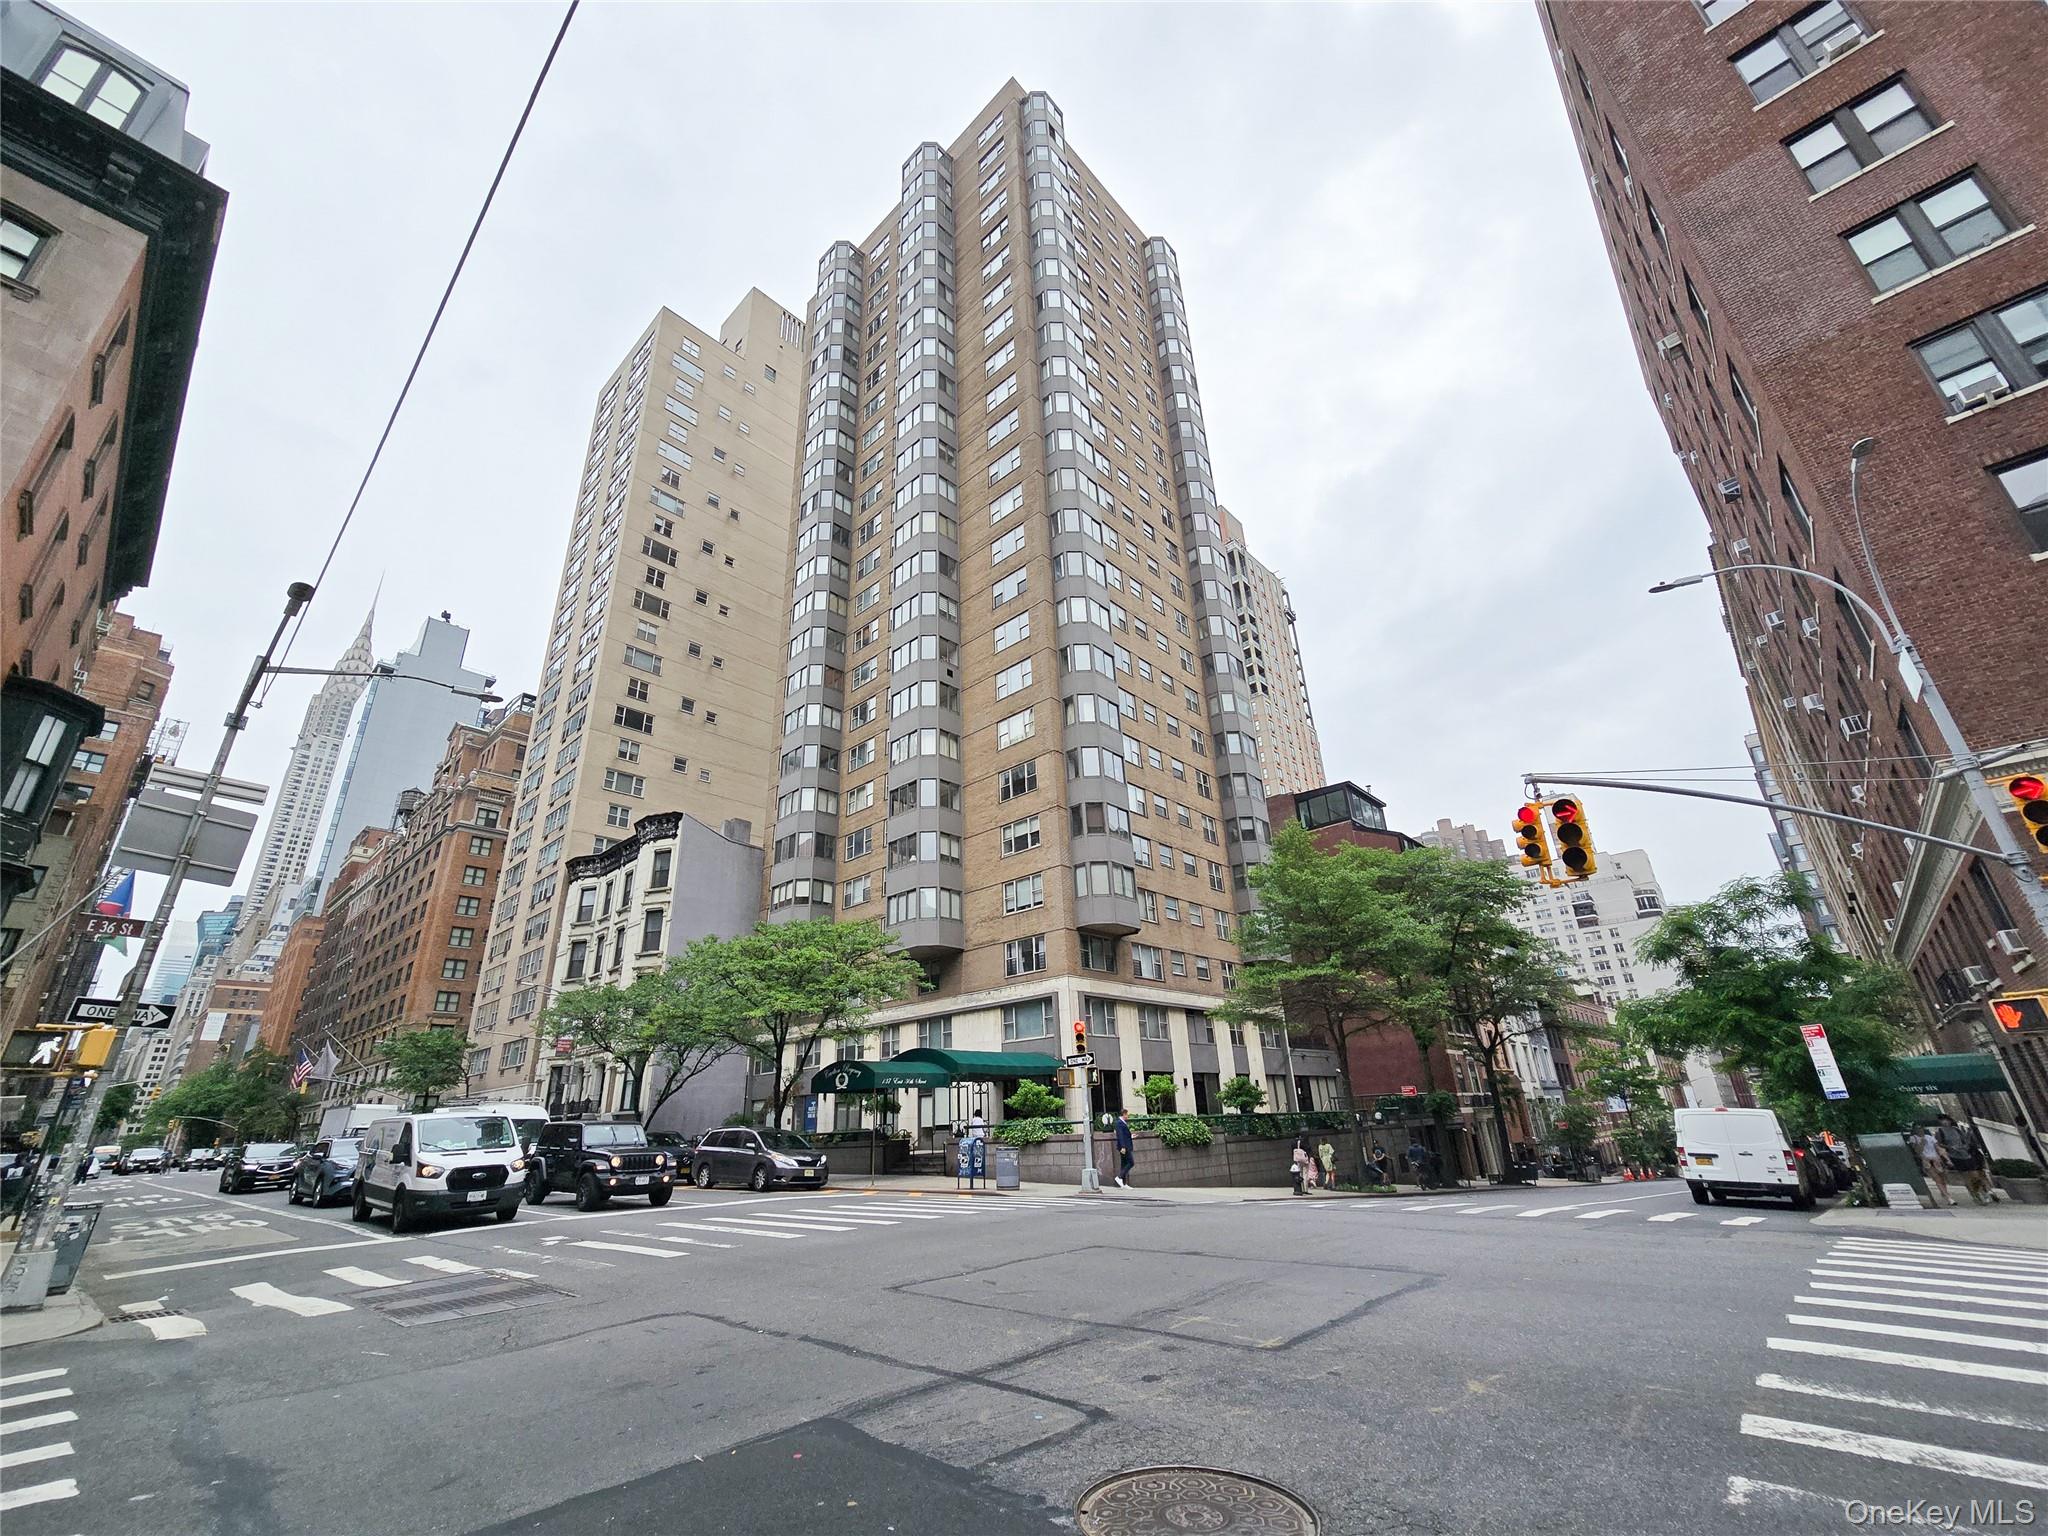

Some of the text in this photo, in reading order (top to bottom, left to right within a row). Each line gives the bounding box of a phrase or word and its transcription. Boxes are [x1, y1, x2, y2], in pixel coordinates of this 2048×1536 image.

[87, 919, 134, 935] E 36 St
[86, 1006, 117, 1018] ONE
